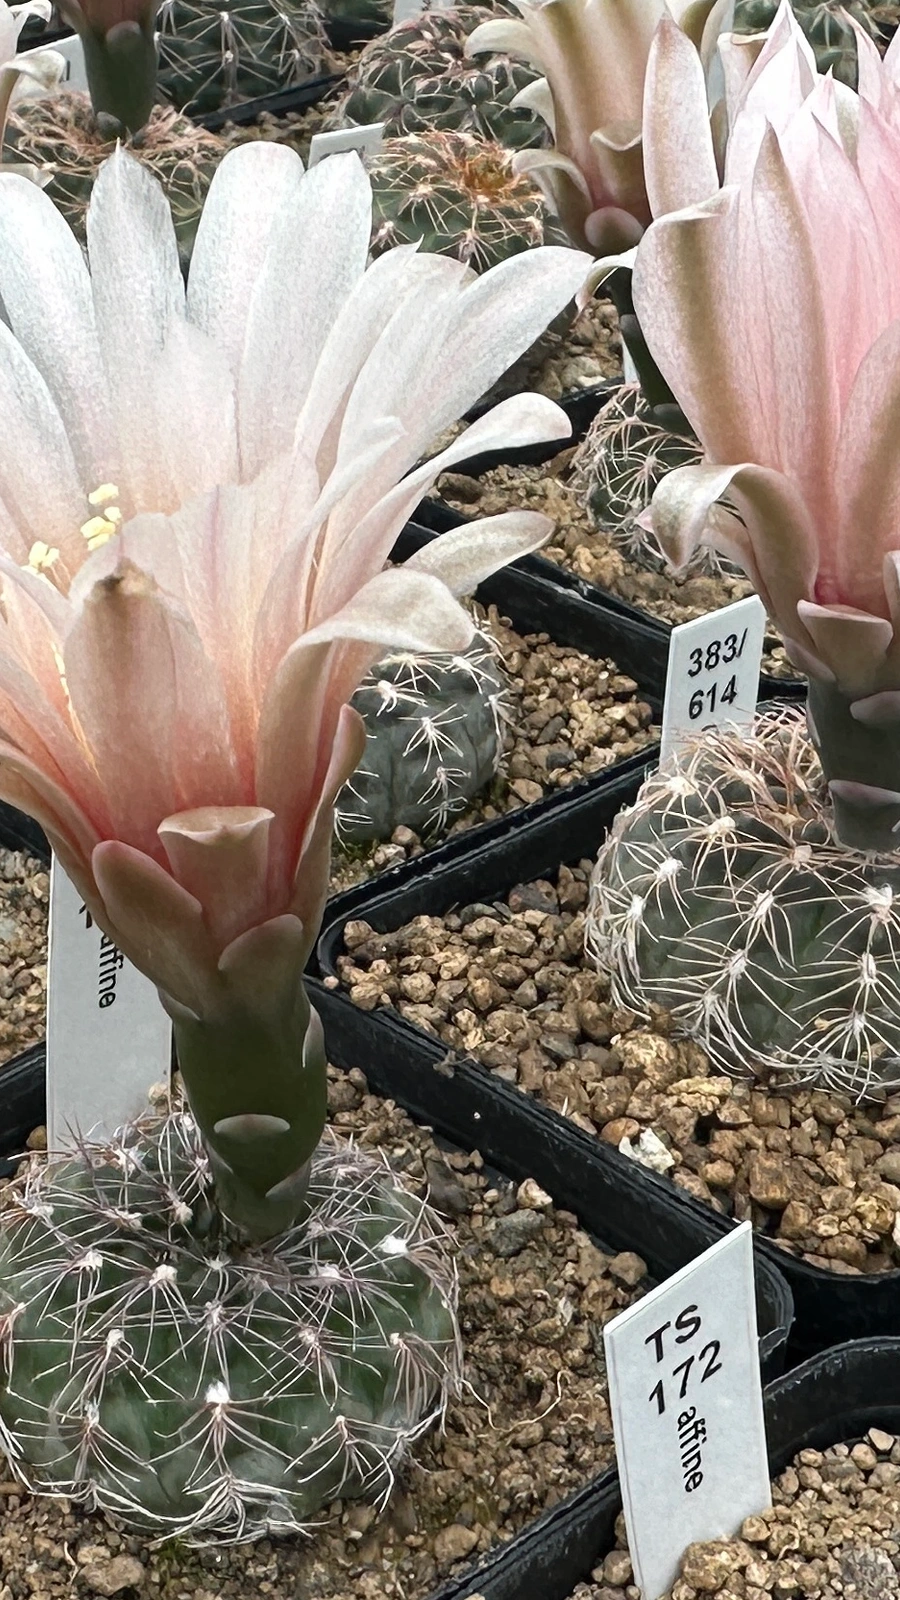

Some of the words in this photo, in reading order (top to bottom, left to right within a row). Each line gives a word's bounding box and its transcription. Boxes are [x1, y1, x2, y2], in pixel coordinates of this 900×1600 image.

[687, 627, 748, 678] 383/
[688, 674, 738, 720] 614
[644, 1304, 702, 1363] TS
[648, 1339, 723, 1415] 172
[677, 1405, 707, 1493] affine
